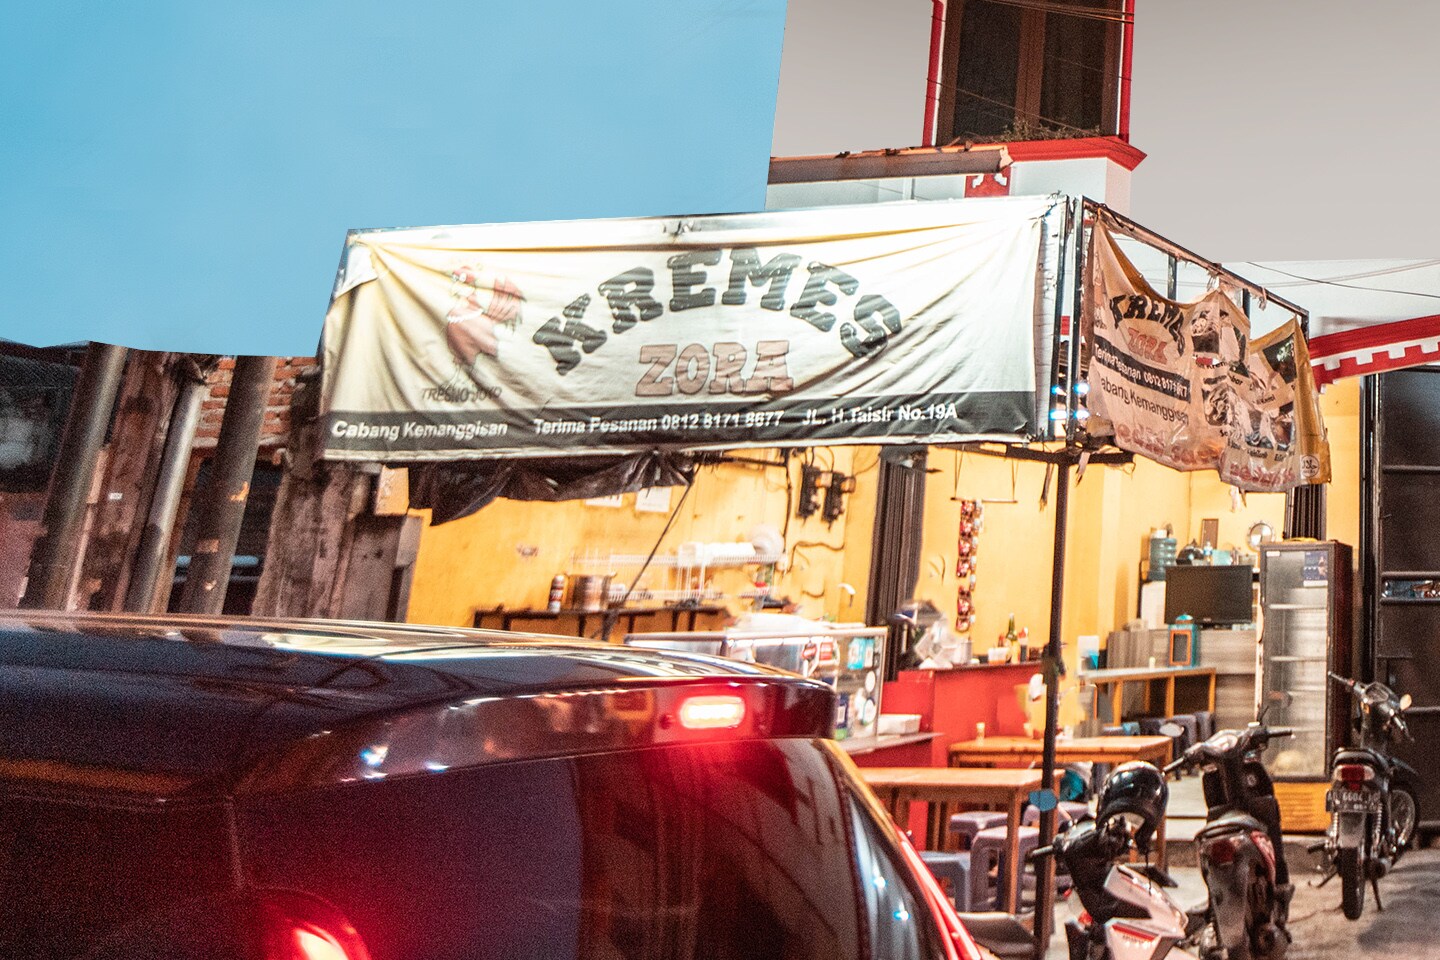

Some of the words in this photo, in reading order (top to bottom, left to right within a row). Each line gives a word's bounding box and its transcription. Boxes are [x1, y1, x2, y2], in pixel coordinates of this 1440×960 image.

[532, 247, 902, 376] KREMES
[635, 340, 794, 397] ZORA
[1100, 377, 1131, 405] abang
[331, 420, 399, 441] Cabang
[402, 421, 508, 440] Kemanggisan
[533, 417, 586, 435] Terima
[589, 415, 658, 433] Pesanan
[661, 413, 700, 431] 0812
[703, 412, 740, 429] 8171
[744, 410, 785, 427] 8677
[898, 402, 958, 421] No.19A
